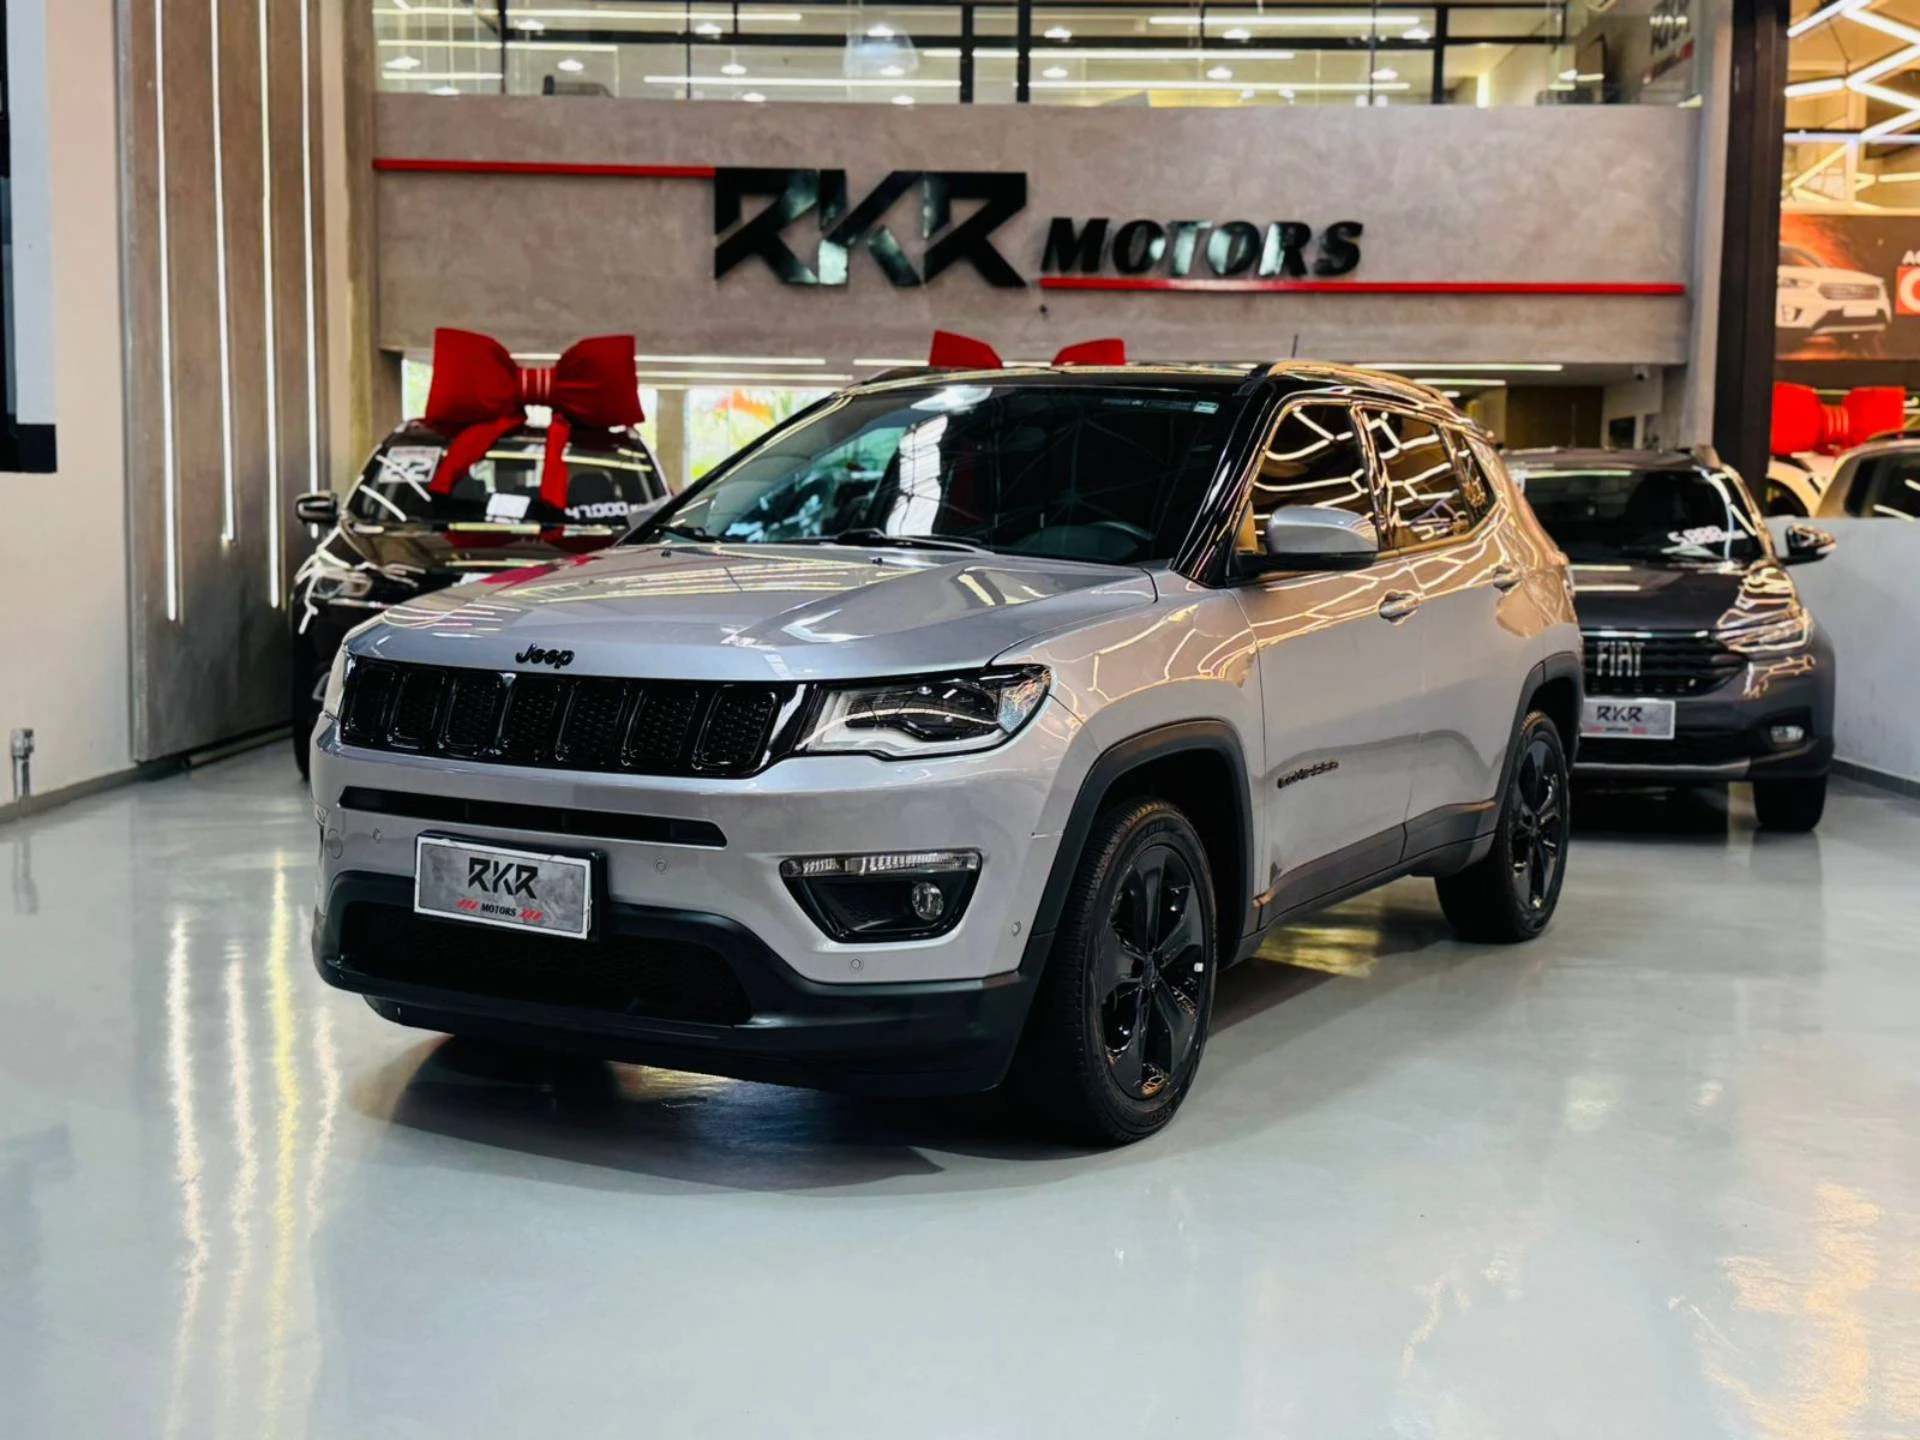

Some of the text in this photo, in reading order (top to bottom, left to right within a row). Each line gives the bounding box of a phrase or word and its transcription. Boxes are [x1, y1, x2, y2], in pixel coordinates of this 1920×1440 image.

[714, 167, 1364, 287] RKR MOTORS
[515, 642, 575, 669] Jeep
[1597, 641, 1646, 677] FIAT
[1596, 705, 1643, 722] RKR
[468, 857, 539, 899] RKR
[480, 903, 516, 917] MOTORS
